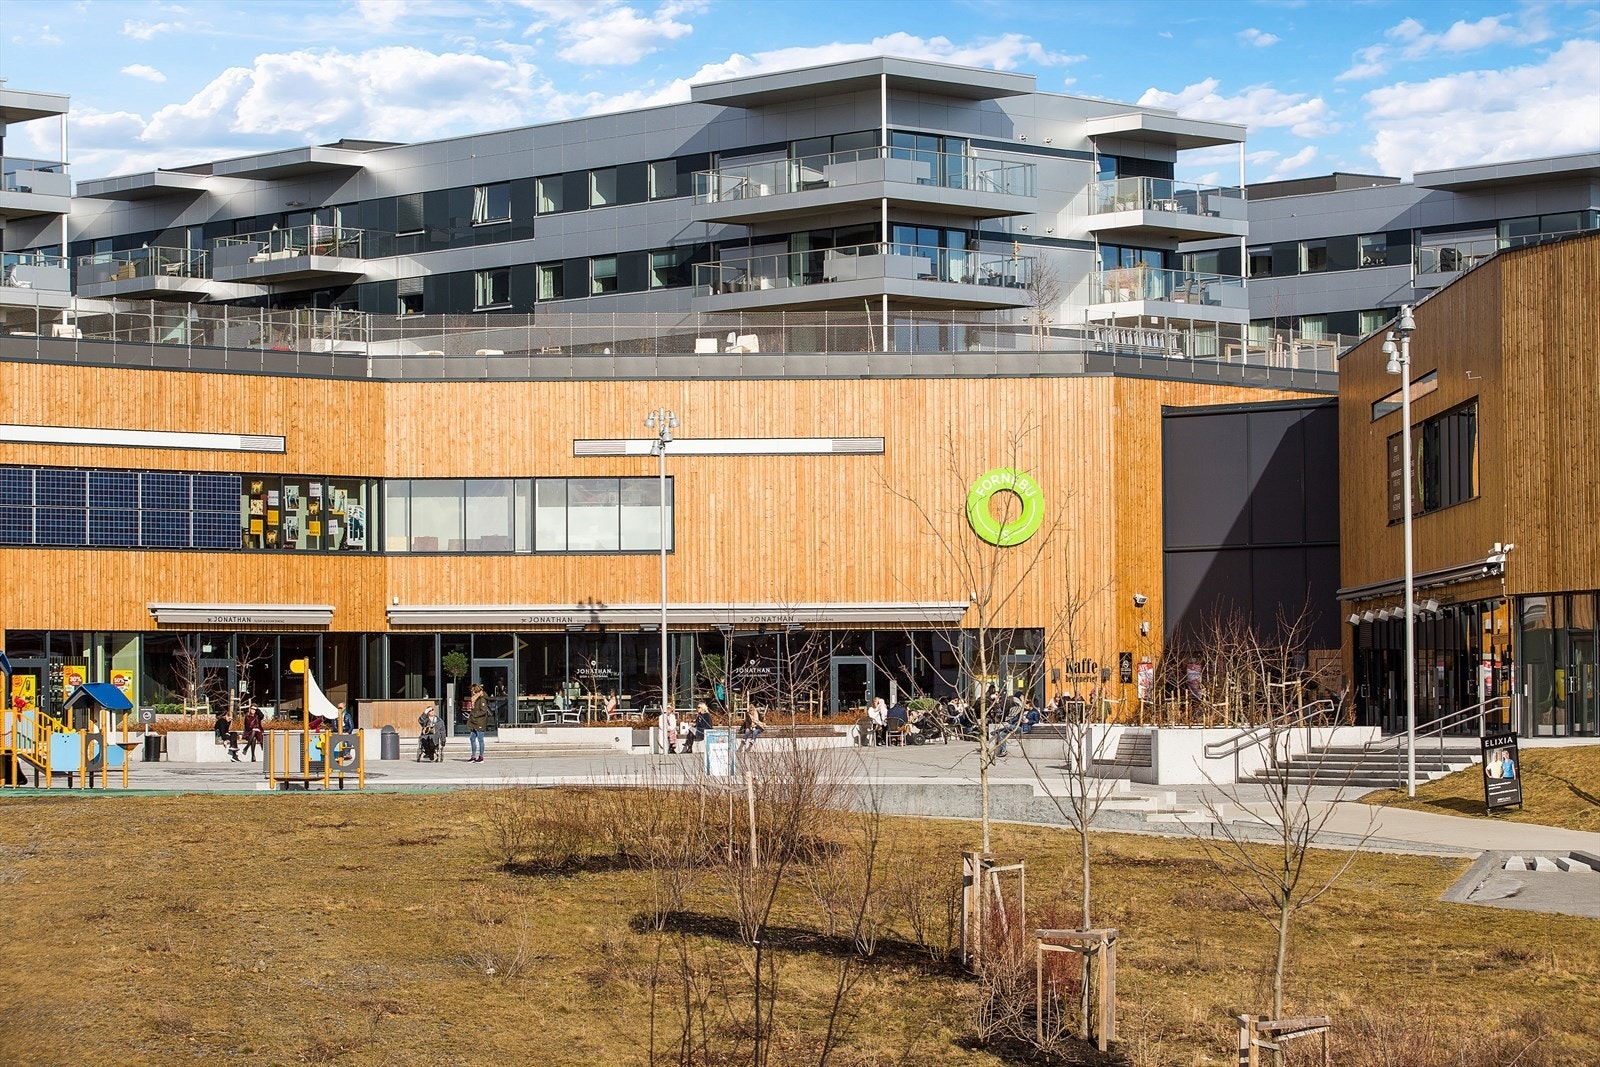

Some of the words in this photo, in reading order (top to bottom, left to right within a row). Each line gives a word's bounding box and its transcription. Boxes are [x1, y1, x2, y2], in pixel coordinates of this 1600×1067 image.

[976, 474, 1036, 496] FORNEBU
[1065, 658, 1098, 674] Kaffe
[1484, 736, 1513, 747] ELIXIA
